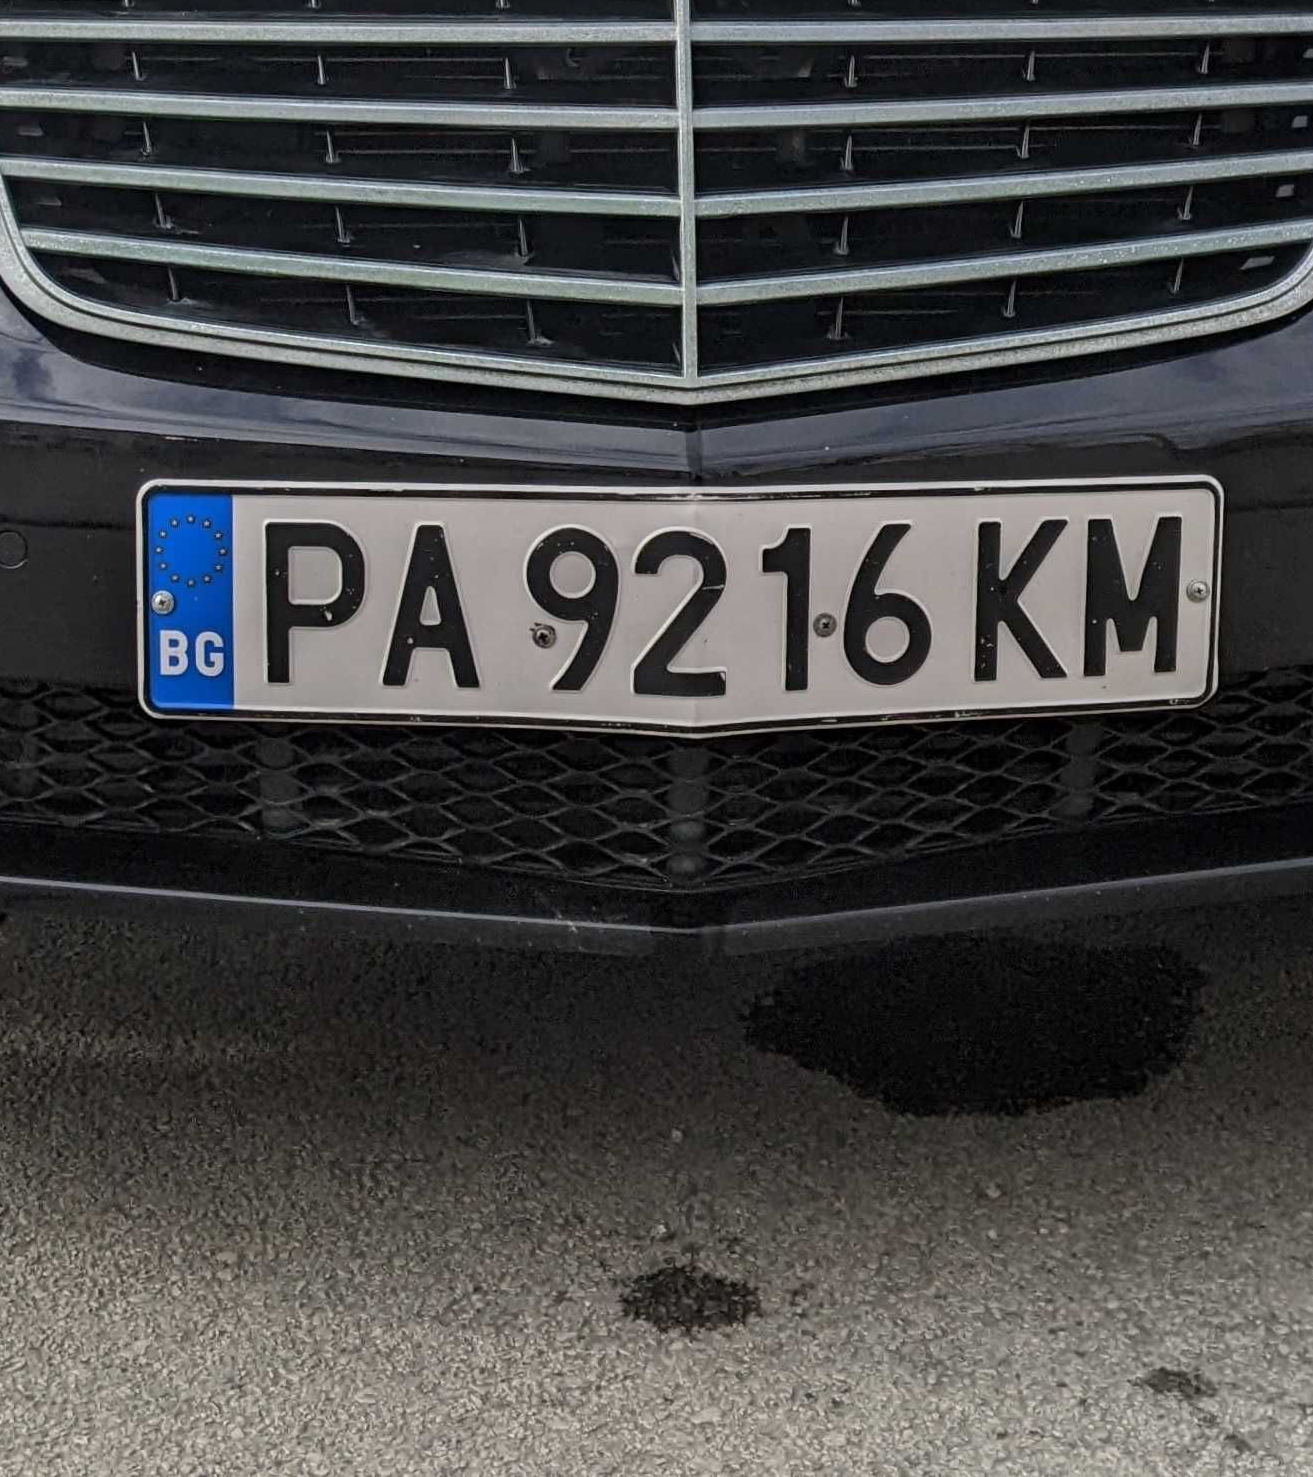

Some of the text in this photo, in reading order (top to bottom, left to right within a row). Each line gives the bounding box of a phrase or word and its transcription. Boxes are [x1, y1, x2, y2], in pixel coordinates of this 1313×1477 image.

[159, 629, 225, 677] BG
[264, 515, 1184, 699] PA 9216 KM
